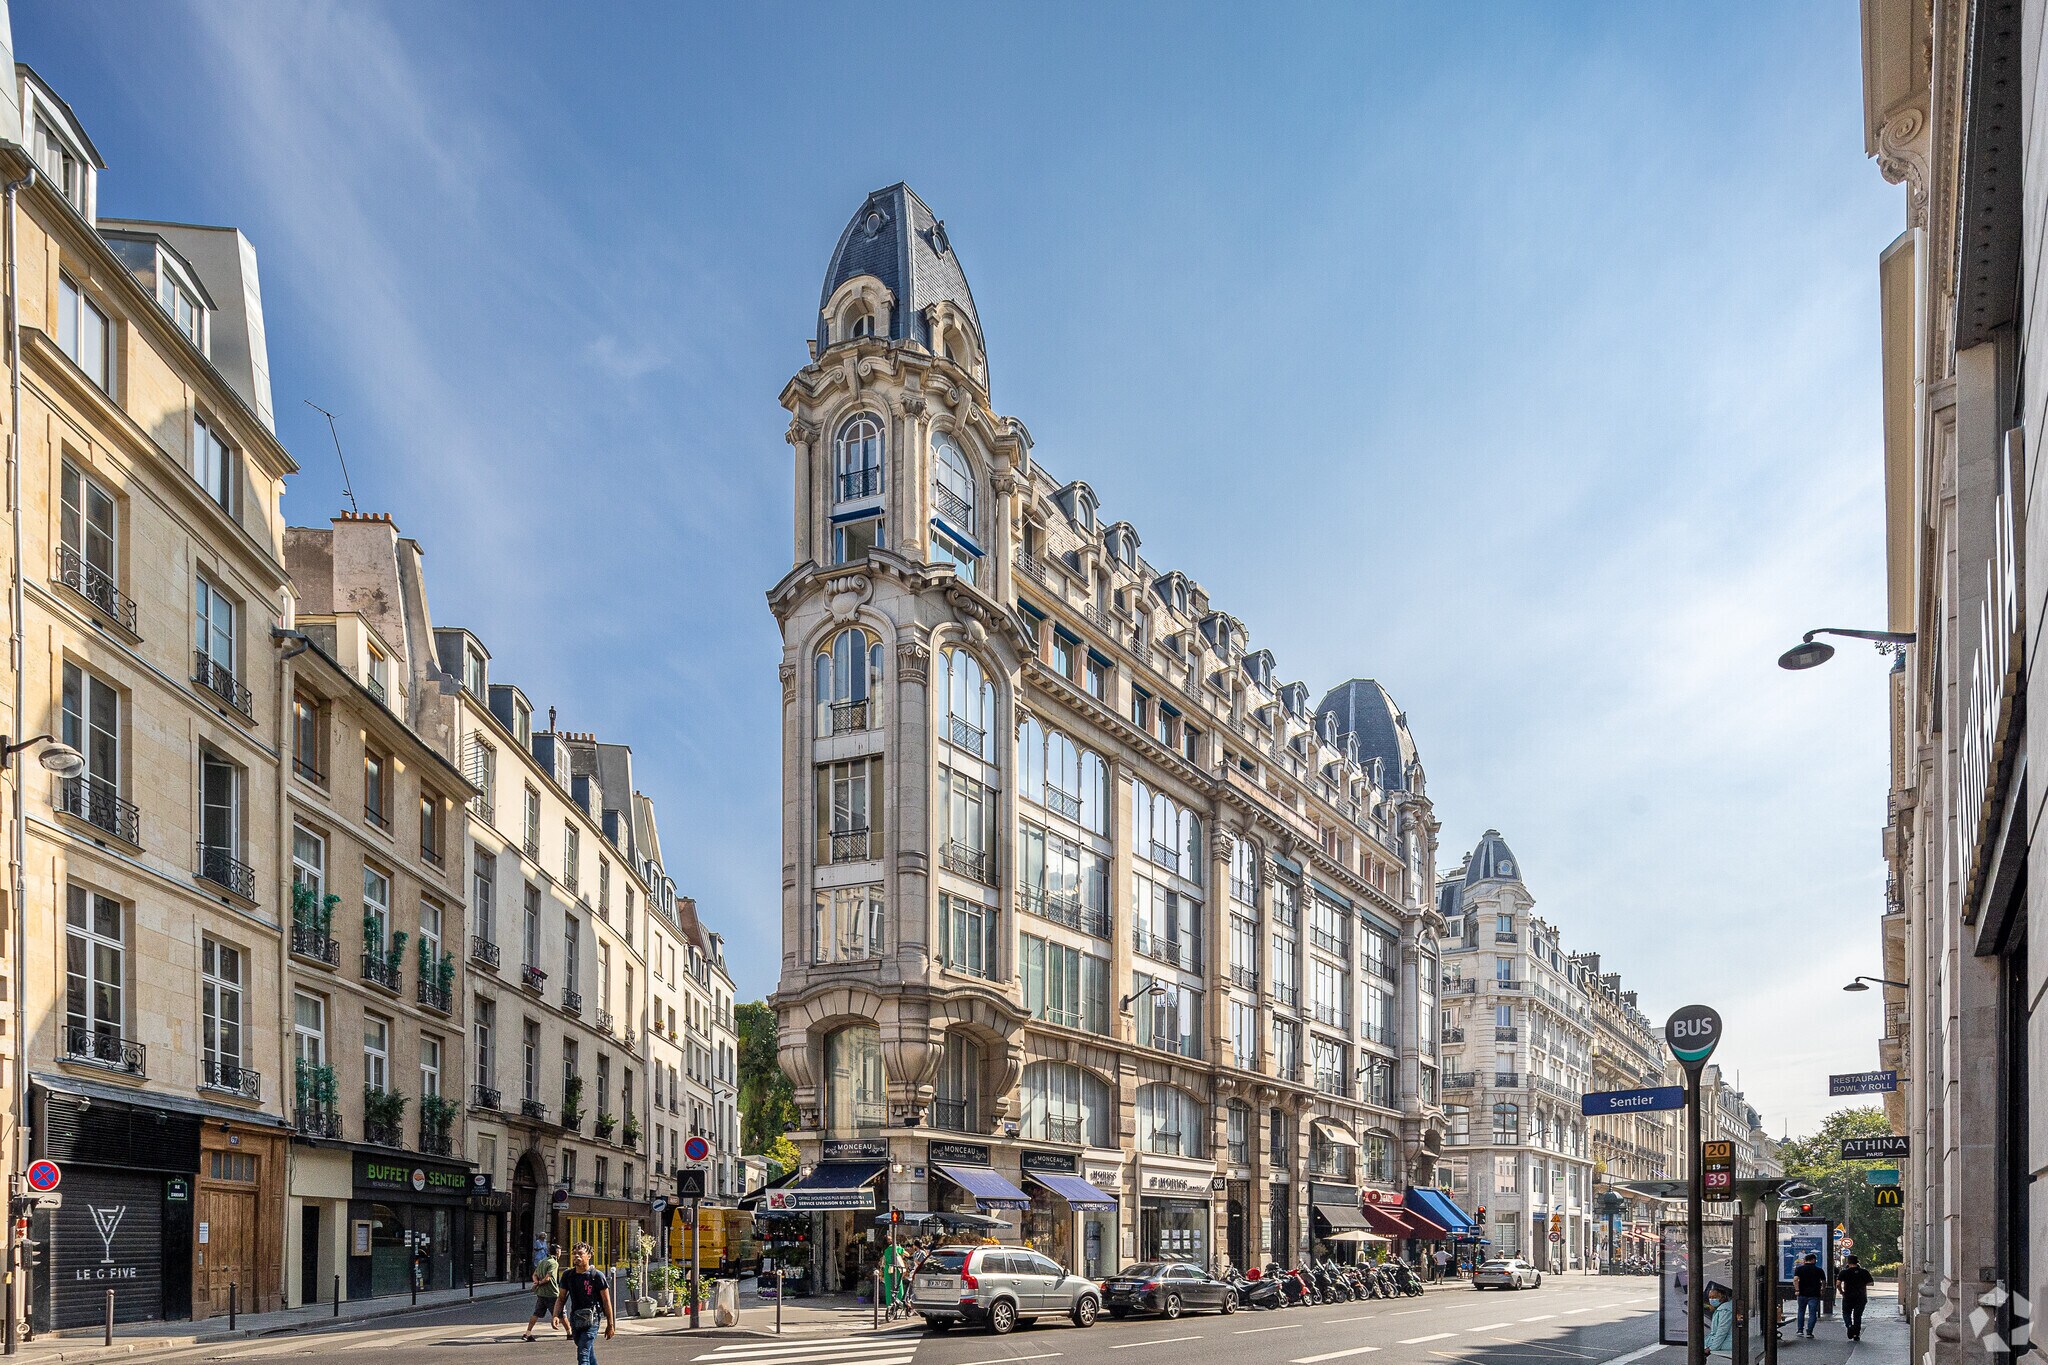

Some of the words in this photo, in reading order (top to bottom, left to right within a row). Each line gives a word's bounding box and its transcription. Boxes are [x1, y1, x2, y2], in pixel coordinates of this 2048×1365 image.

[1674, 1018, 1713, 1038] BUS
[1833, 1073, 1892, 1084] RESTAURANT
[1833, 1085, 1859, 1093] BOWL
[1868, 1082, 1892, 1090] ROLL
[1610, 1095, 1654, 1108] Sentier
[944, 1145, 976, 1155] MONCEAU
[1708, 1144, 1727, 1156] 20
[1844, 1138, 1907, 1152] ATHINA
[1037, 1155, 1064, 1164] MONCEAU
[368, 1163, 410, 1182] BUFFET
[428, 1172, 466, 1188] SENTIER
[1708, 1173, 1727, 1186] 39
[76, 1269, 91, 1280] LE
[110, 1267, 137, 1279] FIVE
